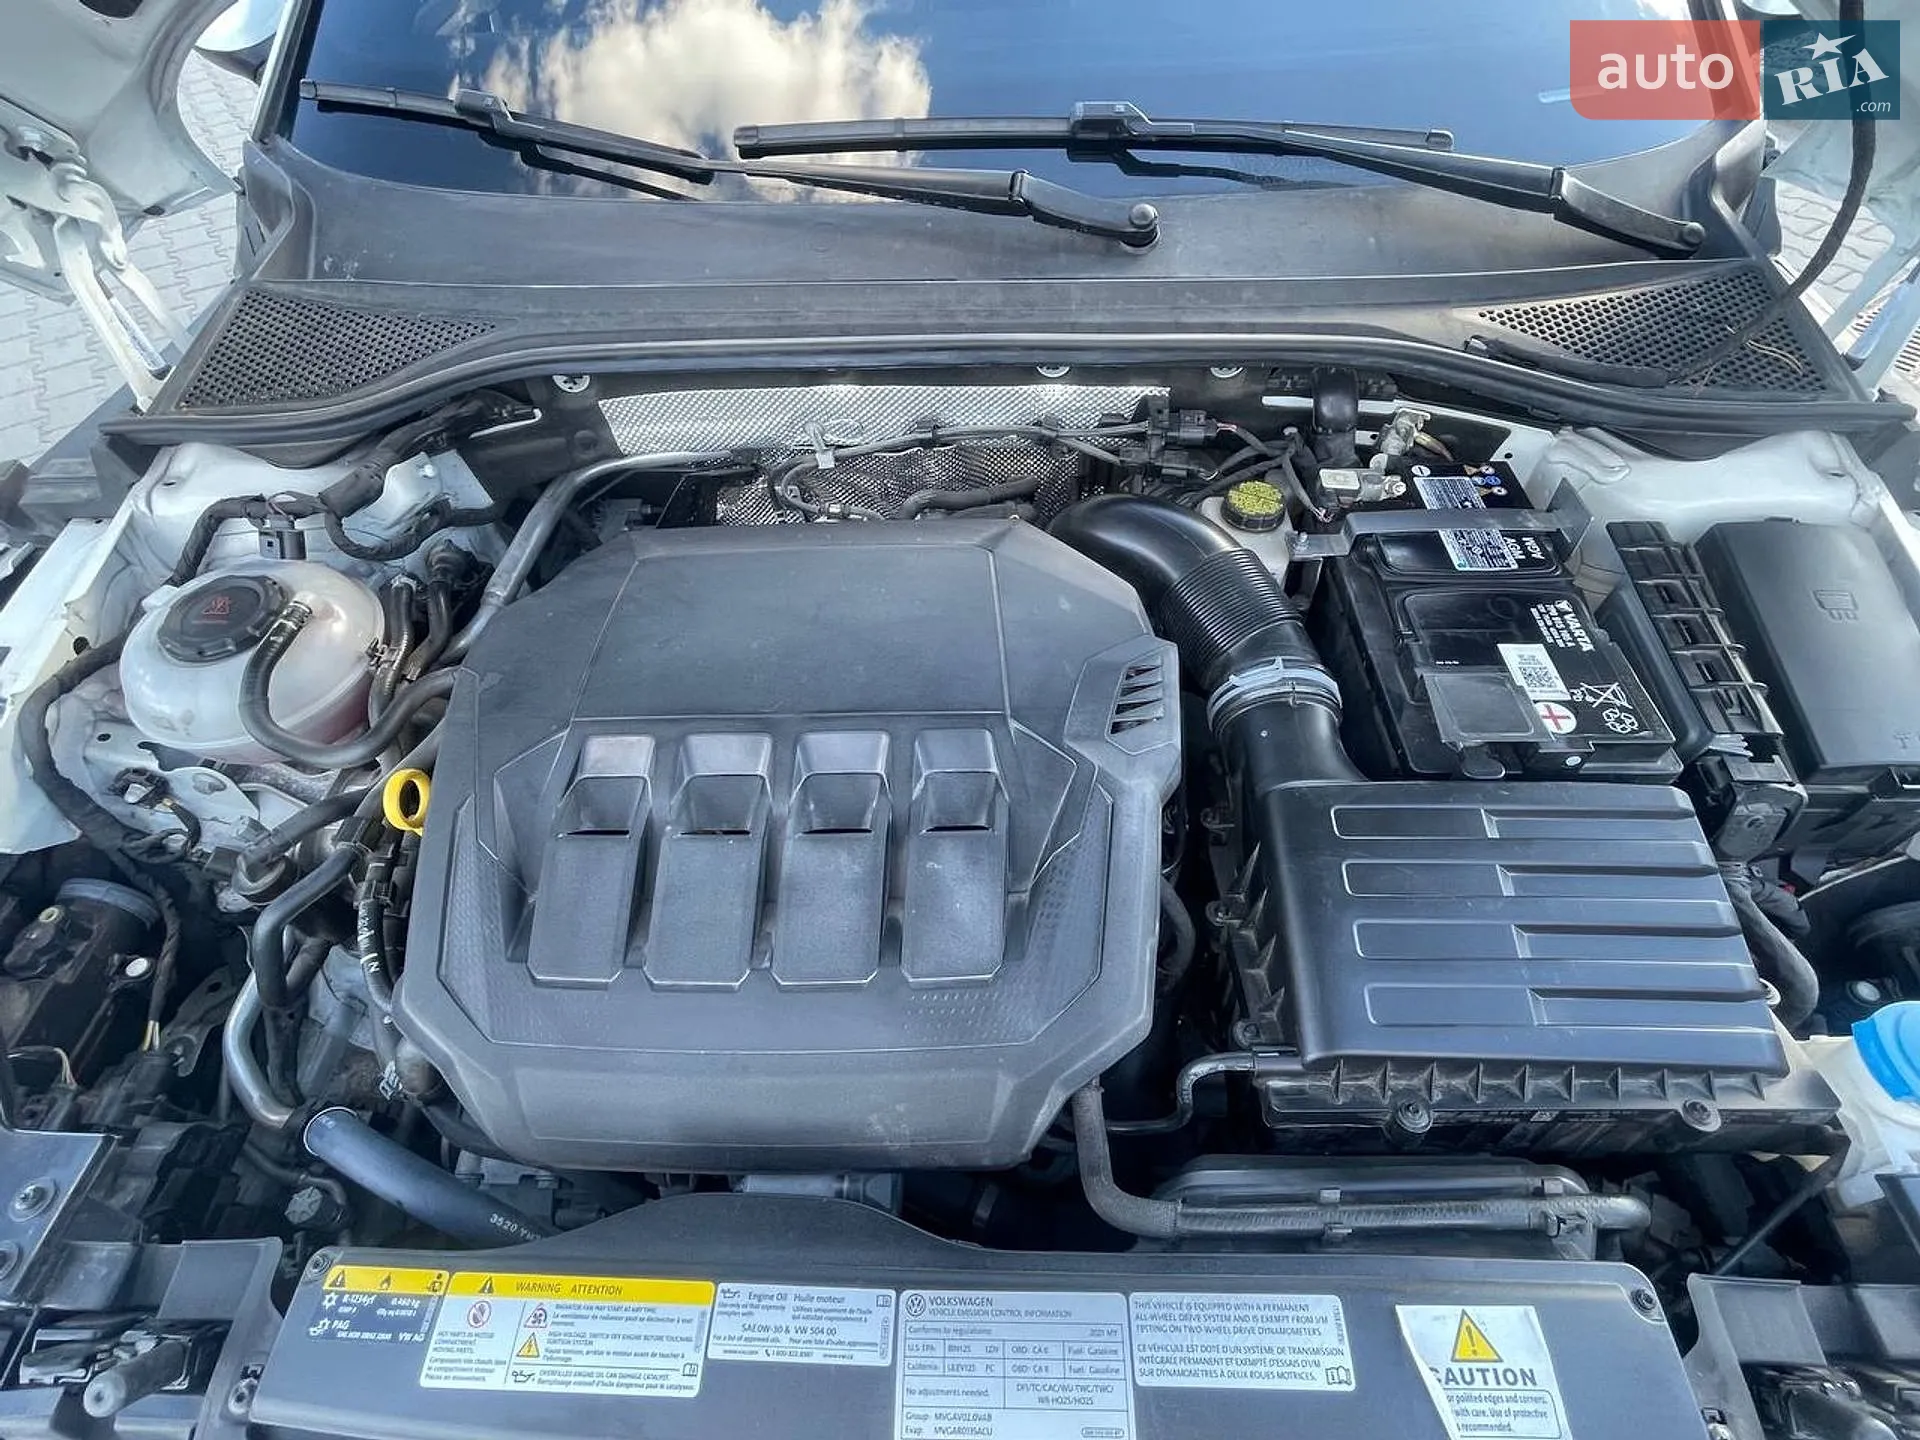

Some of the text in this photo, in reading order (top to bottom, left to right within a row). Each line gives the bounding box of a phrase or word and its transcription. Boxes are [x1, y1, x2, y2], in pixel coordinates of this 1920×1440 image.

[1564, 613, 1596, 652] VARTA
[490, 1212, 519, 1233] 3520
[516, 1282, 622, 1294] WARNING ATTENTION
[749, 1292, 845, 1302] Engine Oil Huile moteur
[928, 1296, 993, 1307] VOLKSWAGEN
[1153, 1302, 1185, 1310] VEHICLE
[1234, 1303, 1254, 1311] WITH
[1202, 1314, 1232, 1322] SYSTEM
[794, 1326, 808, 1334] VW
[810, 1326, 825, 1335] 504
[827, 1327, 836, 1335] 00
[1505, 1394, 1518, 1404] and
[1512, 1409, 1548, 1418] protective
